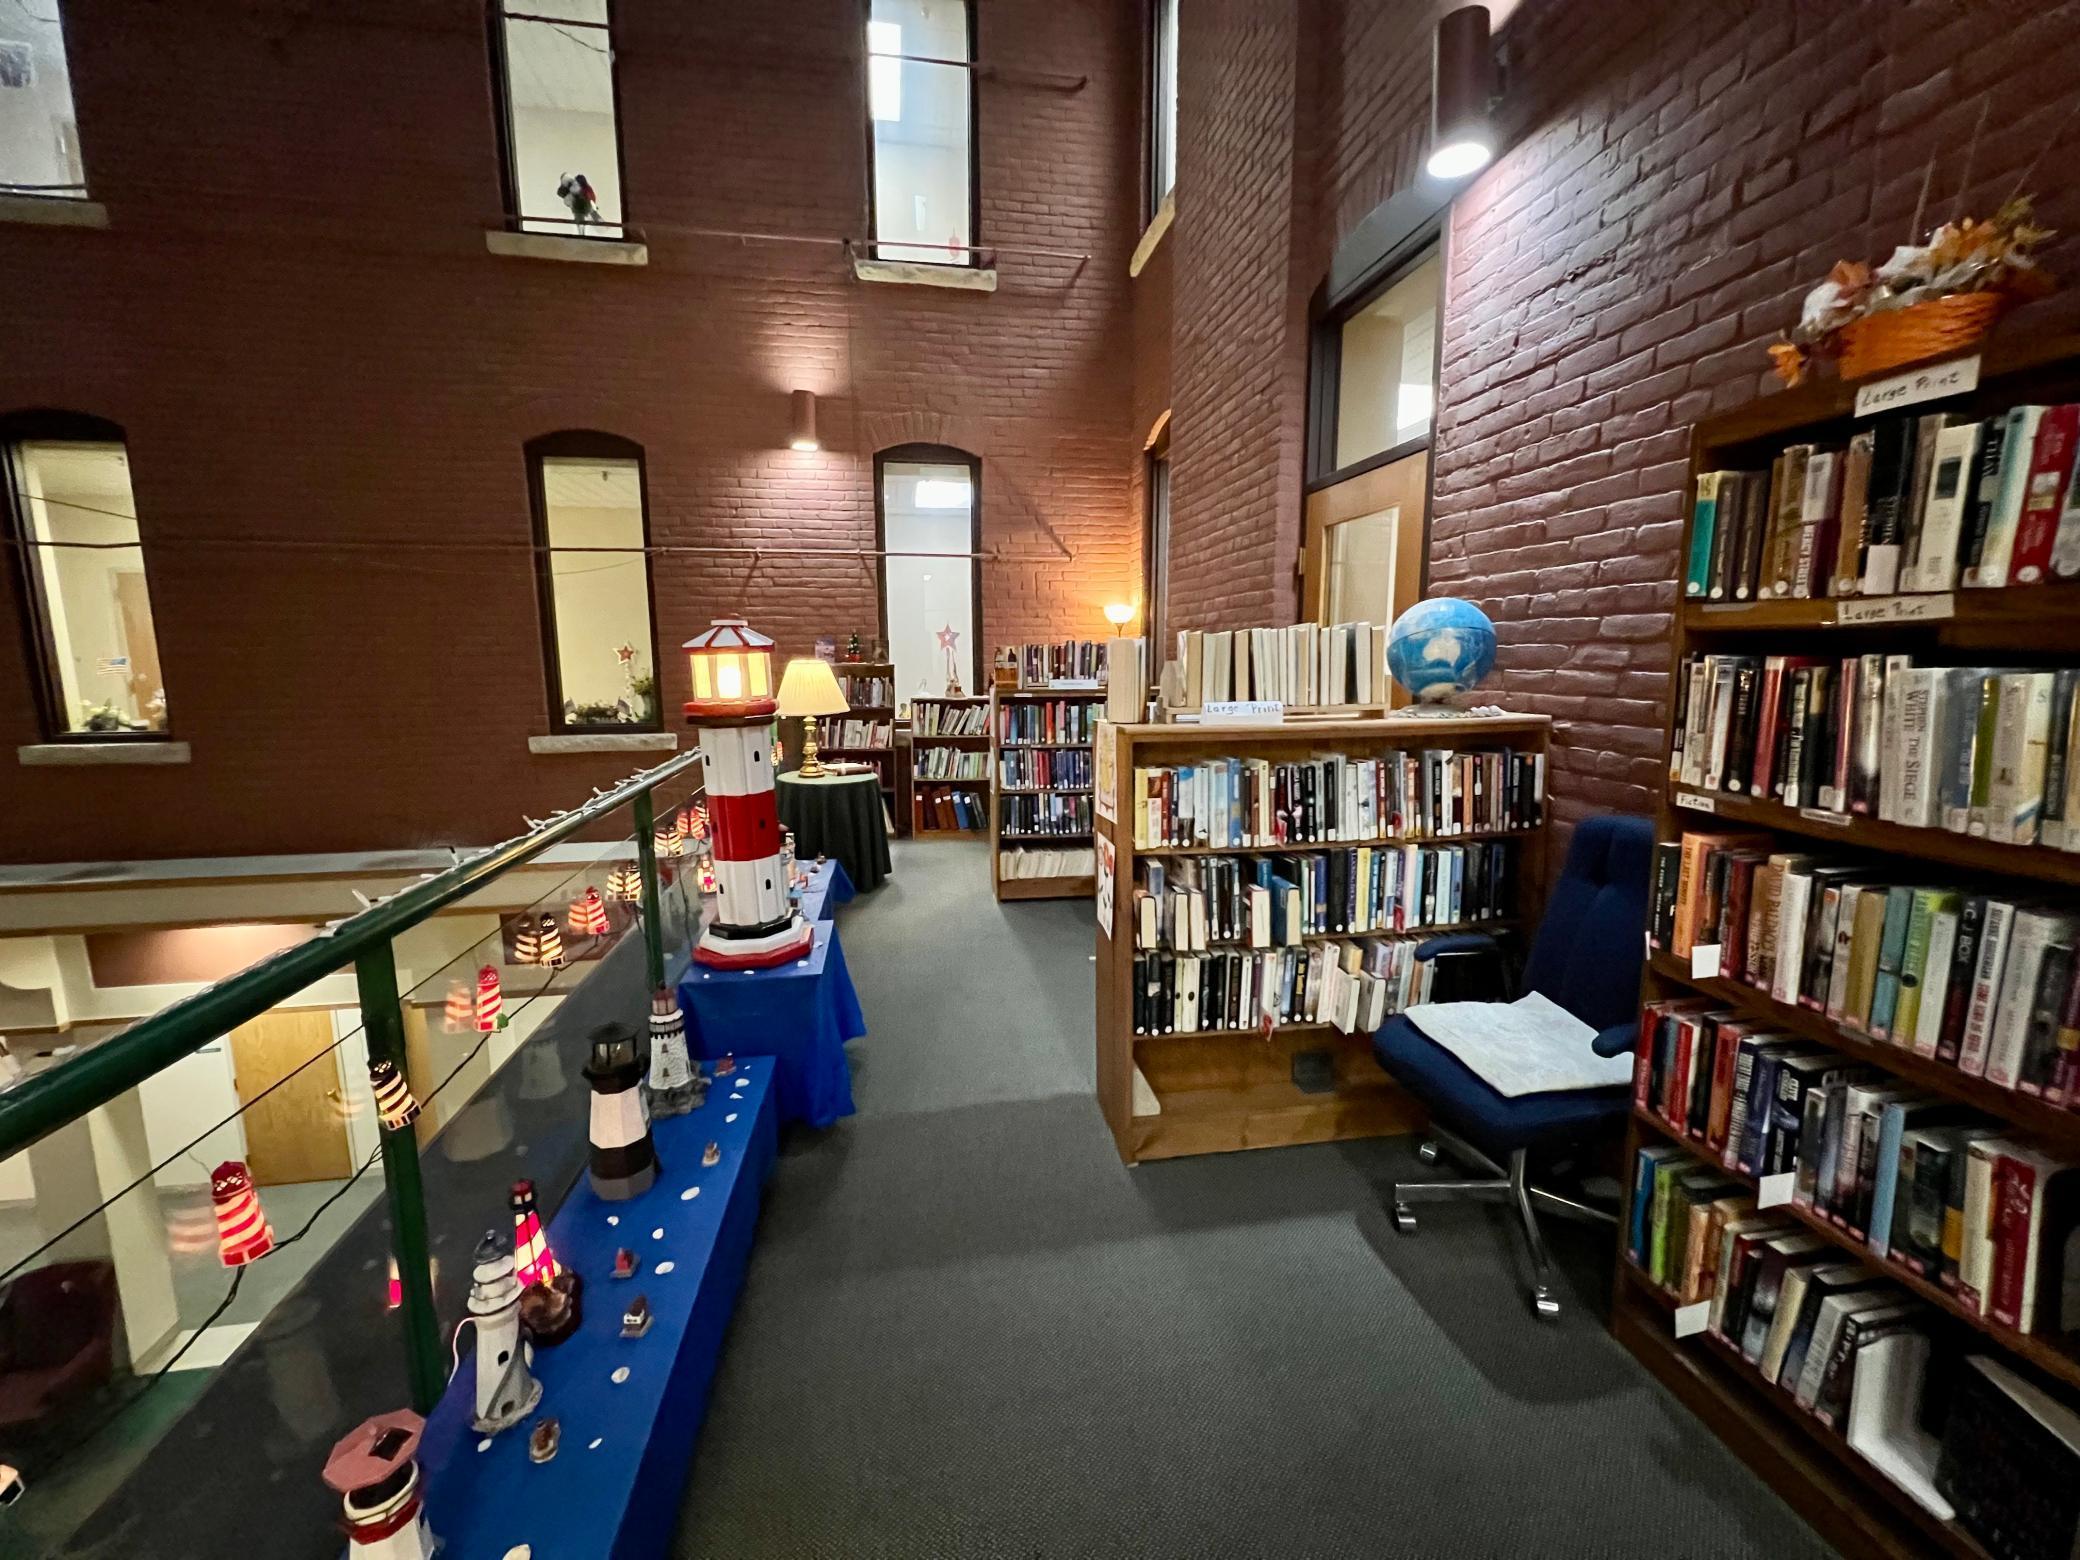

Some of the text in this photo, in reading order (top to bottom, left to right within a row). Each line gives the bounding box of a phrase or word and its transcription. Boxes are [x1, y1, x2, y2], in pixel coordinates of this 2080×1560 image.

[1861, 370, 1960, 408] Large Print
[1843, 600, 1927, 620] Large Print
[1206, 703, 1280, 715] Large Print
[1904, 690, 1919, 732] WHITE
[1903, 761, 1920, 801] SIEGE
[1678, 793, 1711, 809] Fiction
[1767, 863, 1785, 899] DAVID
[1763, 900, 1781, 952] BALDACCI
[1958, 935, 1973, 964] BOX
